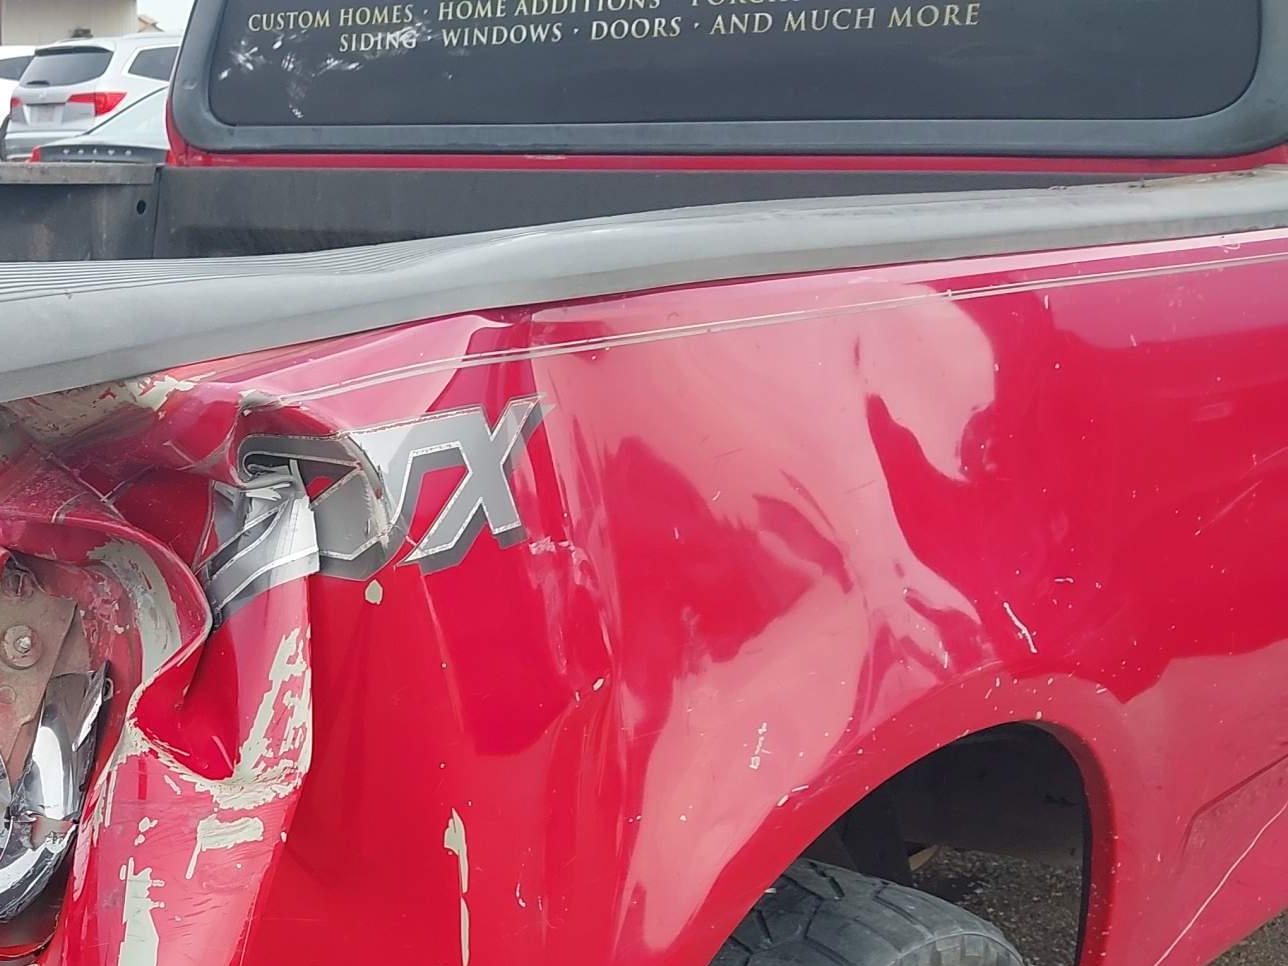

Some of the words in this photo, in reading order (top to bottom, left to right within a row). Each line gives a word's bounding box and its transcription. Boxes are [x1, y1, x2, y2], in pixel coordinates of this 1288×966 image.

[248, 11, 331, 32] CUSTOM
[339, 4, 414, 27] HOMES
[438, 0, 507, 20] HOME
[338, 29, 418, 52] SIDING
[441, 23, 562, 46] WINDOWS
[591, 16, 682, 40] DOORS
[709, 12, 773, 35] AND
[783, 7, 876, 32] MUCH
[888, 3, 981, 28] MORE
